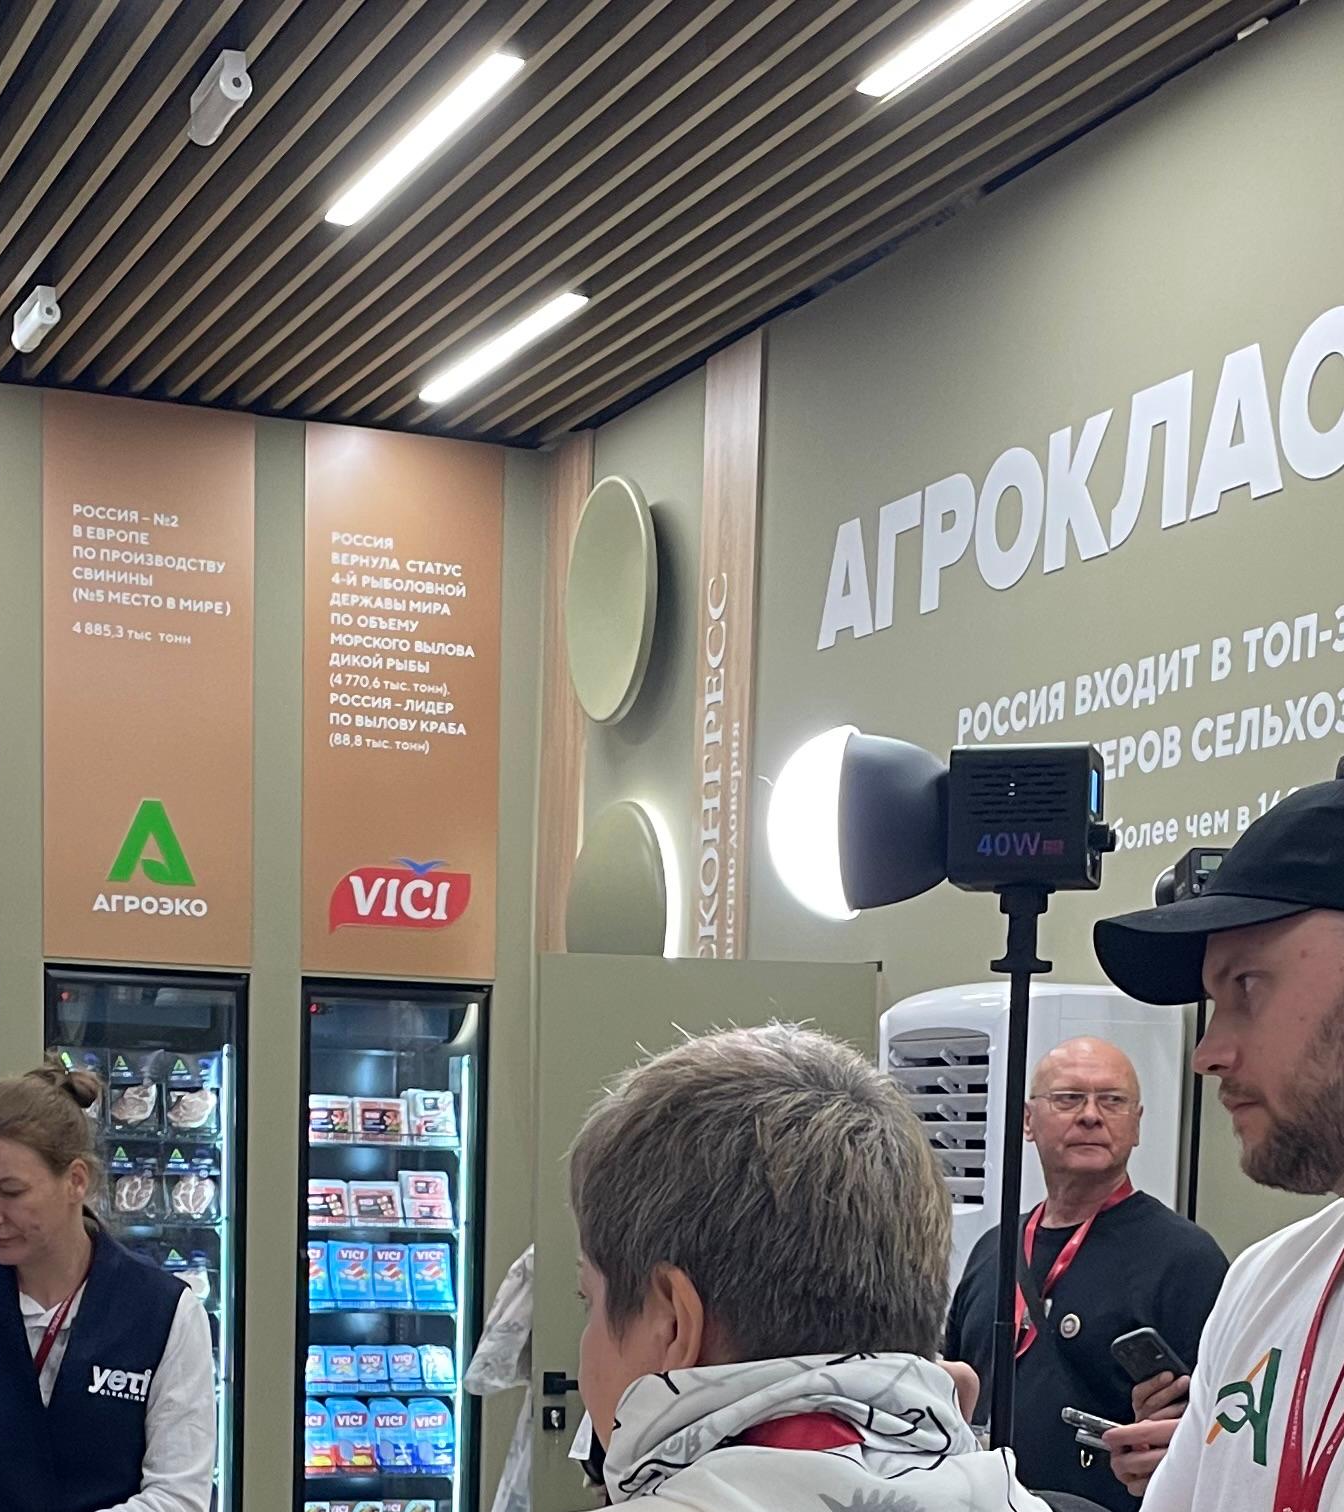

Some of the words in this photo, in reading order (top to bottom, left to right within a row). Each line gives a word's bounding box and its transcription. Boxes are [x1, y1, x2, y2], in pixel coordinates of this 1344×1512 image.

[72, 503, 139, 523] РОССИЯ
[153, 512, 179, 528] №2
[72, 525, 83, 538] В
[86, 526, 150, 545] ЕВРОПЕ
[331, 531, 394, 550] РОССИЯ
[72, 545, 96, 560] ПО
[100, 548, 226, 574] ПРОИЗВОДСТВУ
[331, 552, 400, 571] ВЕРНУЛА
[405, 559, 462, 578] СТАТУС
[72, 566, 153, 587] СВИНИНЫ
[331, 570, 357, 586] 4-Й
[361, 574, 466, 598] РЫБОЛОВНОЙ
[72, 587, 105, 603] (№5
[107, 590, 163, 608] МЕСТО
[166, 597, 176, 610] В
[179, 598, 231, 617] МИРЕ)
[329, 592, 406, 612] ДЕРЖАВЫ
[409, 600, 452, 616] МИРА
[71, 621, 82, 634] 4
[158, 632, 192, 644] тонн
[330, 612, 353, 626] ПО
[357, 615, 419, 633] ОБЪЕМУ
[330, 632, 410, 652] МОРСКОГО
[414, 640, 476, 658] ВЫЛОВА
[329, 652, 383, 669] ДИКОЙ
[386, 657, 430, 674] РЫБЫ
[957, 680, 1066, 746] РОССИЯ
[1074, 642, 1201, 717] ВХОДИТ
[1210, 636, 1233, 682] В
[329, 692, 392, 710] РОССИЯ
[403, 699, 454, 715] ЛИДЕР
[329, 712, 352, 726] ПО
[355, 714, 418, 732] ВЫЛОВУ
[419, 720, 467, 736] КРАБА
[1094, 725, 1182, 781] ЕРОВ
[1185, 808, 1230, 839] чем
[976, 831, 1041, 857] 40W
[92, 892, 208, 918] АГРОЭКО
[348, 875, 451, 921] VICI
[341, 1249, 364, 1260] VICI
[376, 1251, 401, 1261] VICI
[87, 1365, 153, 1396] yeti
[336, 1414, 363, 1426] VICI
[376, 1415, 403, 1426] VICI
[415, 1415, 443, 1427] VICI
